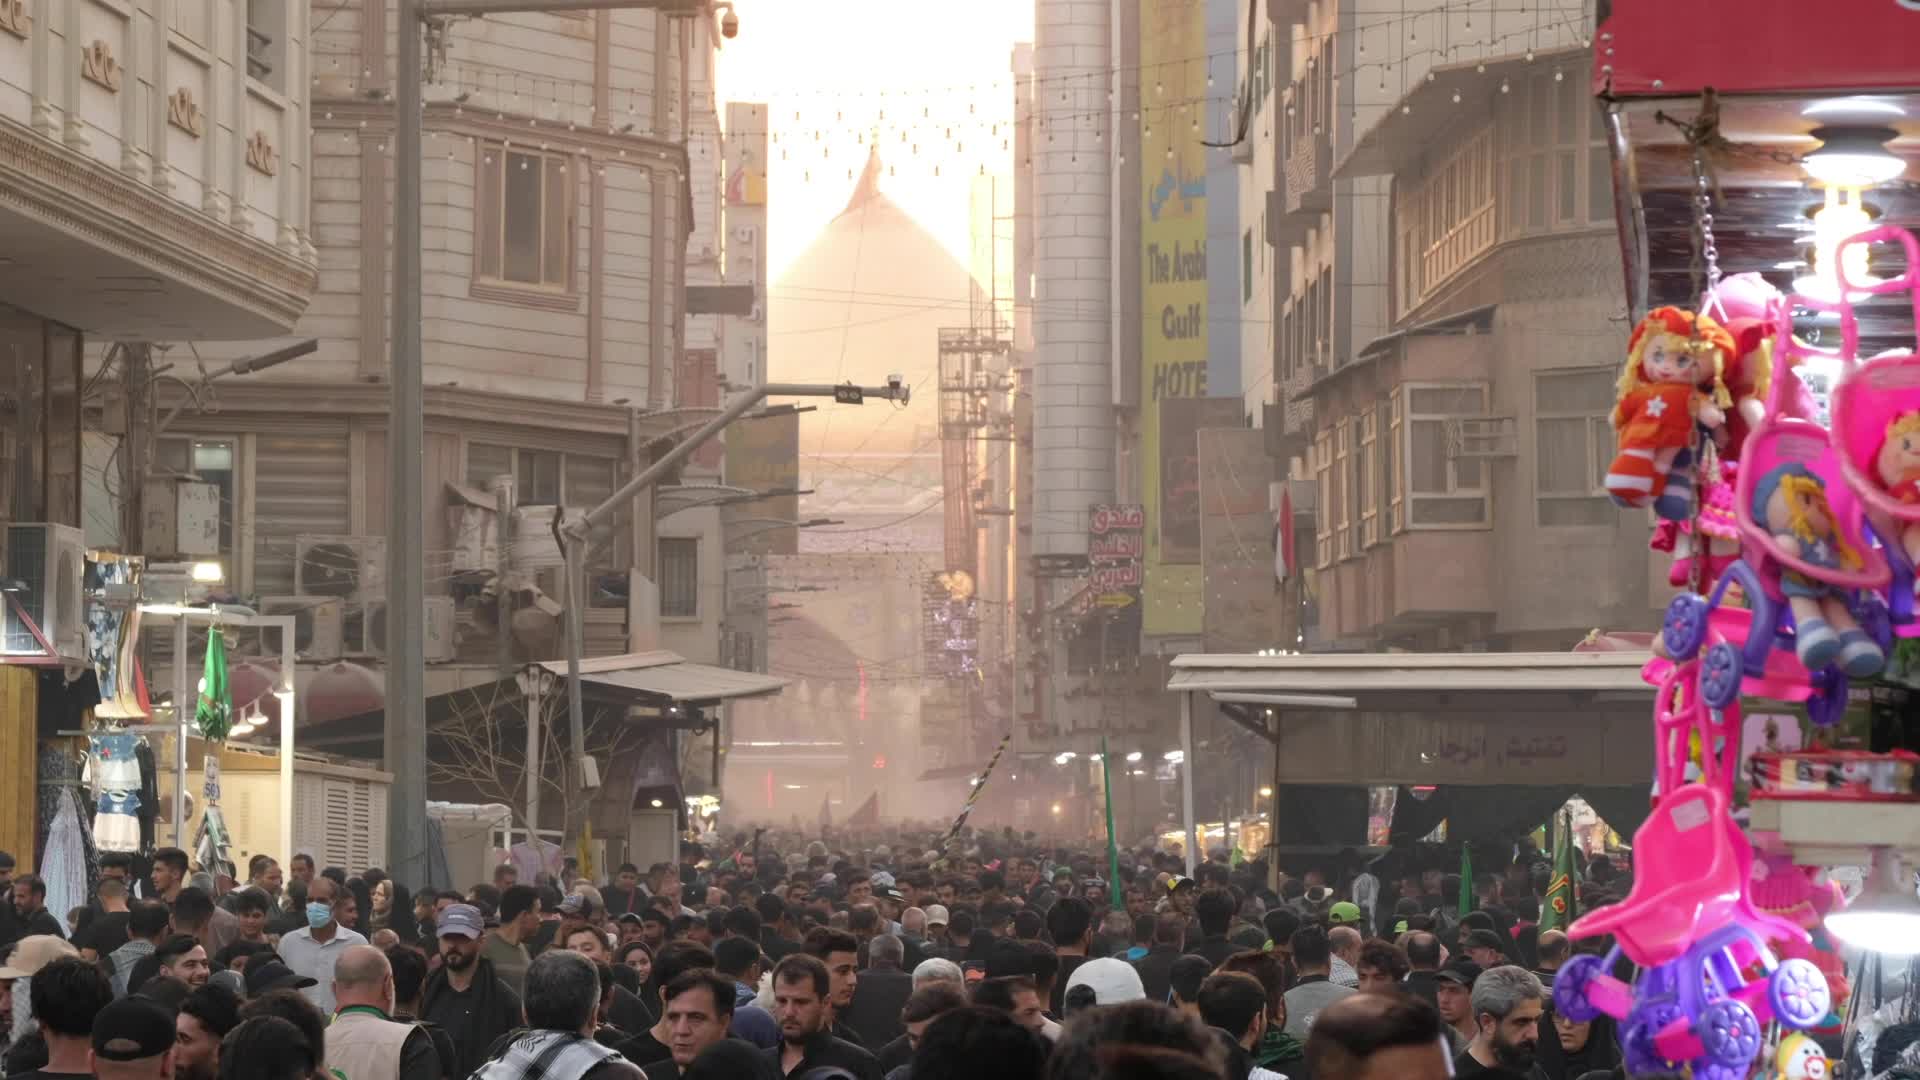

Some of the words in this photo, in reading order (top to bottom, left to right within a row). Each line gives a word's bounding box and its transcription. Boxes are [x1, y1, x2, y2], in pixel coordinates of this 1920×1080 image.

[1149, 244, 1169, 284] The
[1162, 303, 1201, 340] Gulf
[1090, 504, 1143, 534] فندق
[1089, 534, 1142, 563] الخليج
[1089, 562, 1142, 593] العربي
